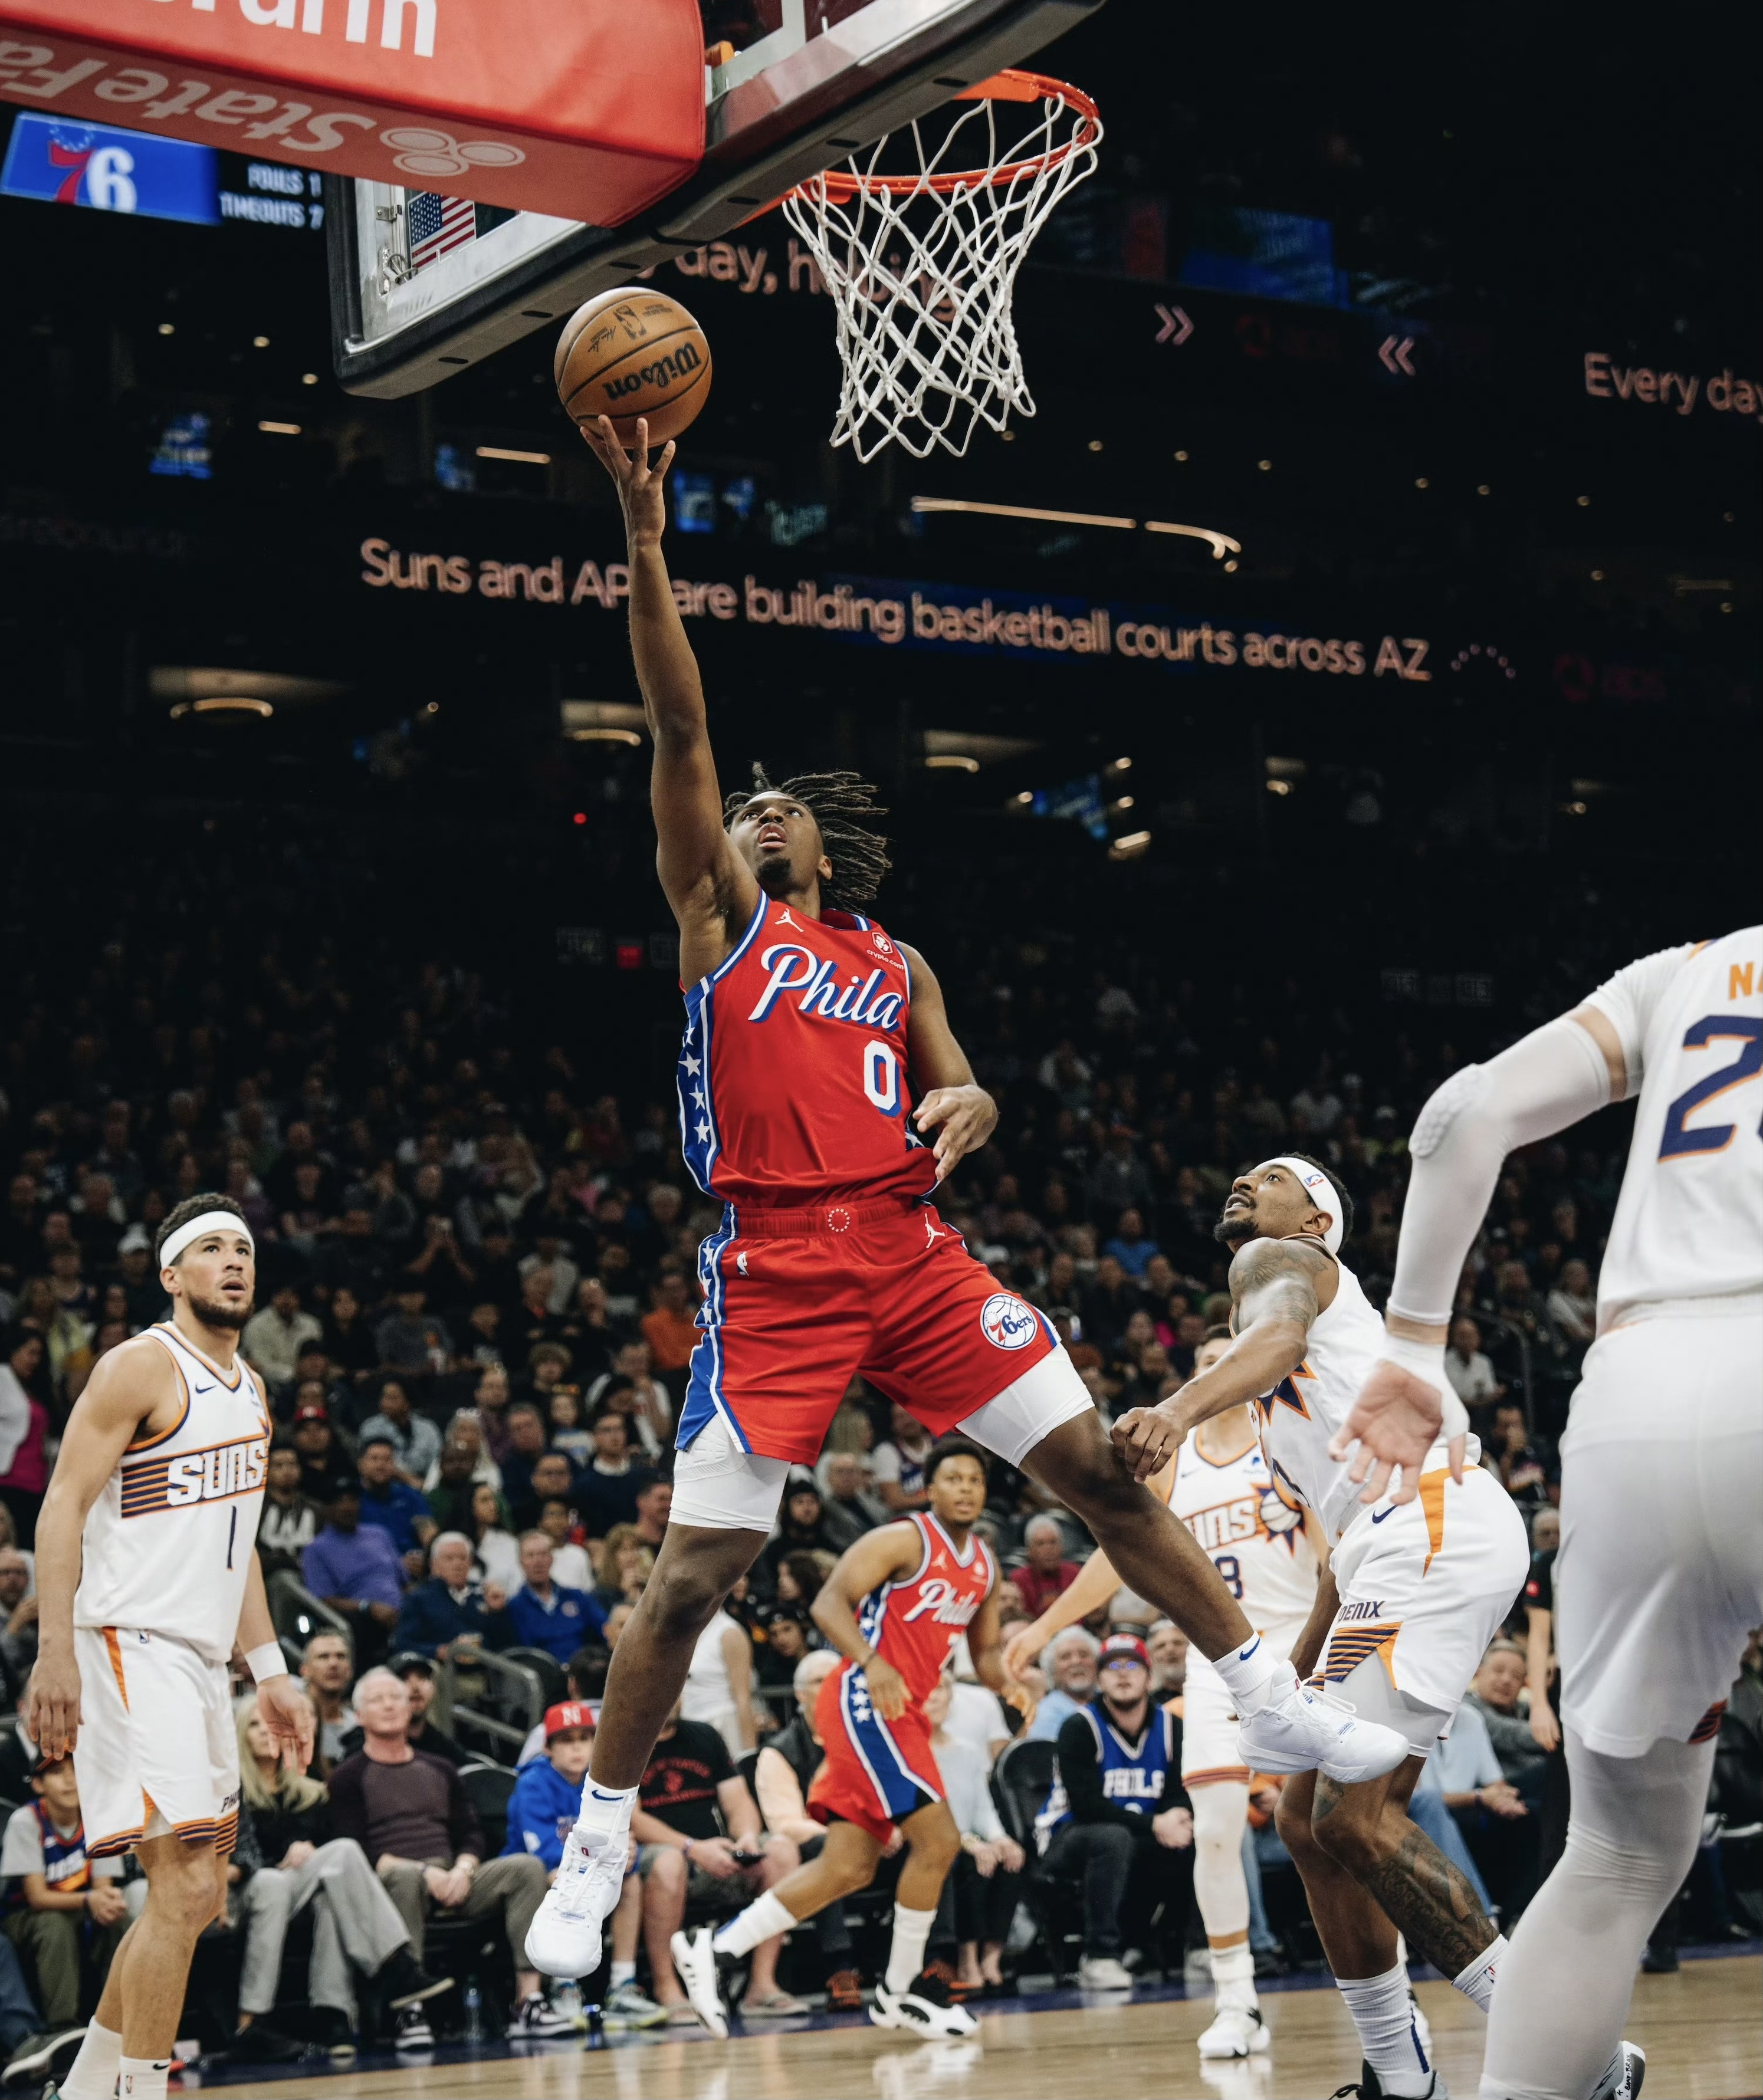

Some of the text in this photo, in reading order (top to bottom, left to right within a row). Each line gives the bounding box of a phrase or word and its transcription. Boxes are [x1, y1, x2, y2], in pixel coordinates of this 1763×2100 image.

[219, 192, 306, 228] TIMEOUTS
[602, 342, 702, 401] Wilson
[1584, 352, 1700, 416] Every
[360, 538, 1431, 682] Suns and AP are building basketball courts across AZ
[748, 944, 905, 1033] Phila
[866, 949, 904, 970] crypto.com
[864, 1039, 900, 1116] 0
[1657, 1014, 1763, 1164] 2
[166, 1437, 267, 1506] SUNS
[226, 1505, 237, 1572] 1
[1181, 1500, 1256, 1550] UNS
[1338, 1601, 1386, 1622] OENIX
[562, 1705, 582, 1727] N
